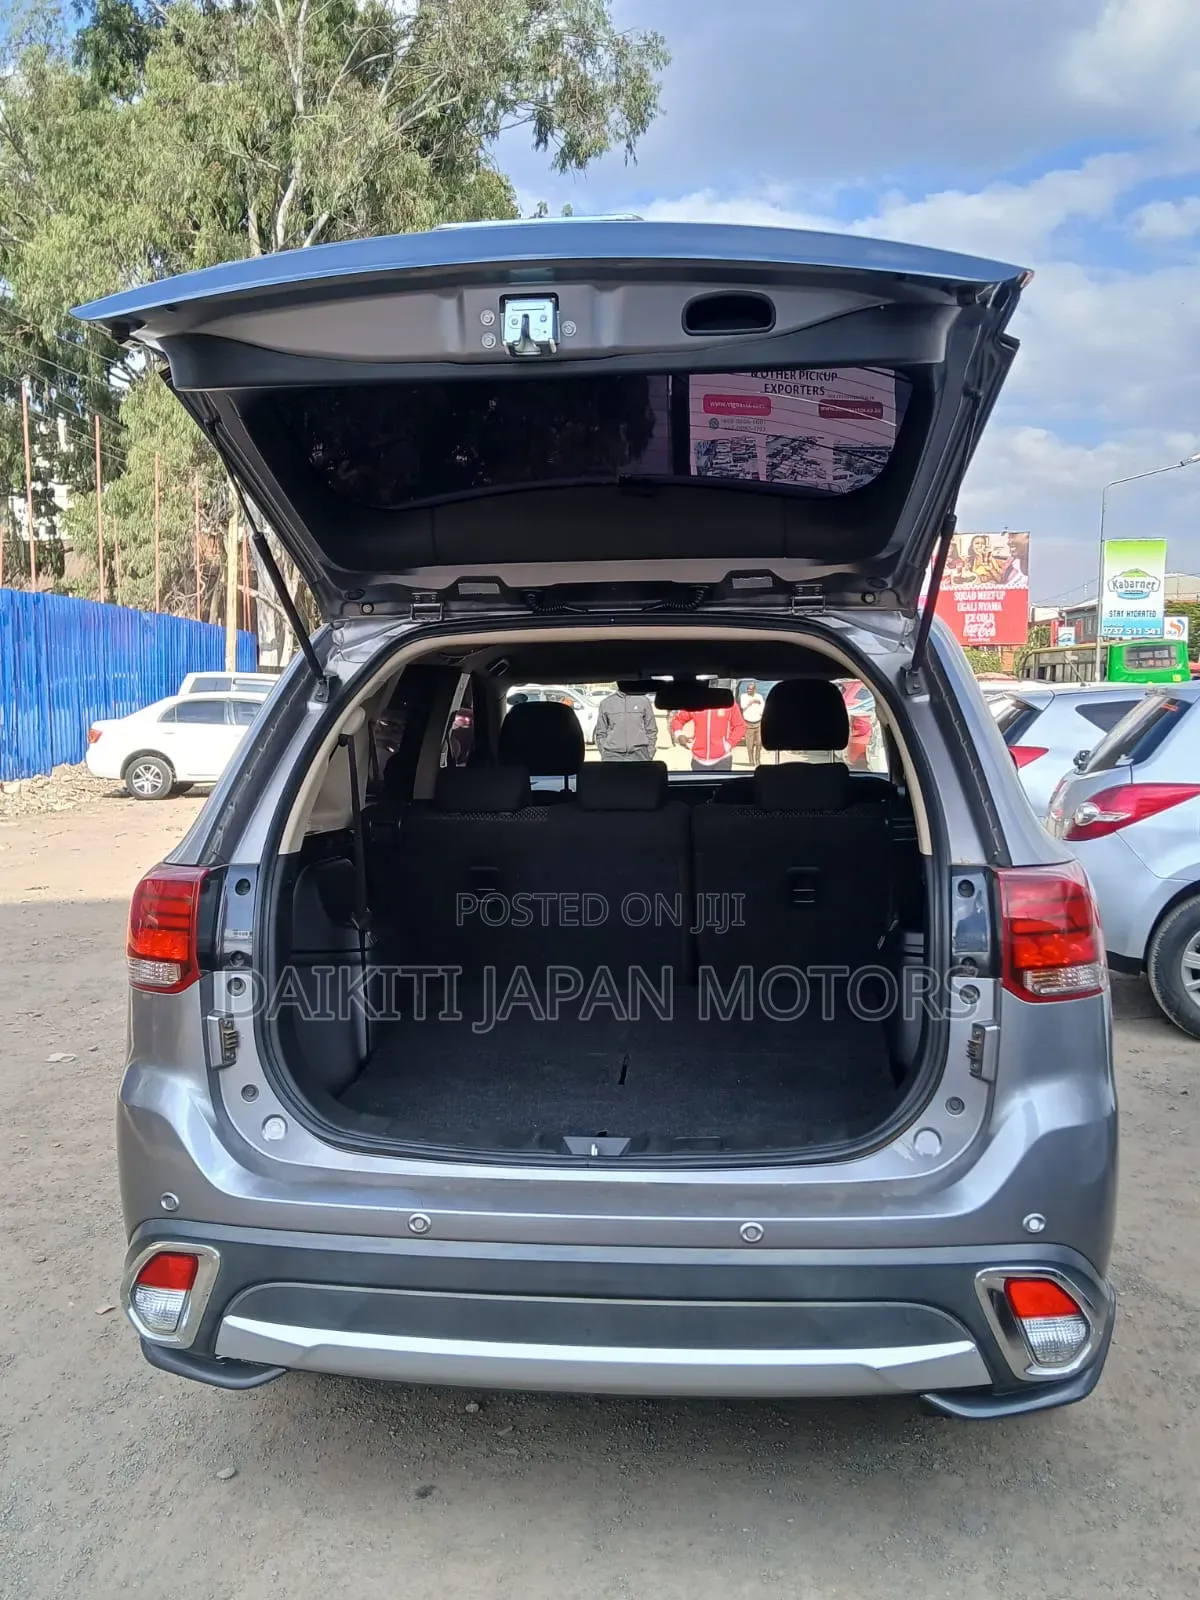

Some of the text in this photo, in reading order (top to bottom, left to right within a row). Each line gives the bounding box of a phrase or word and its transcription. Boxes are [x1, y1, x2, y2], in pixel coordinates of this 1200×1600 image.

[761, 370, 797, 380] OTHER
[799, 370, 838, 382] PICKUP
[764, 383, 825, 396] EXPORTERS
[1112, 579, 1156, 590] Kabarnet
[1109, 609, 1157, 618] STAY HYDRATED
